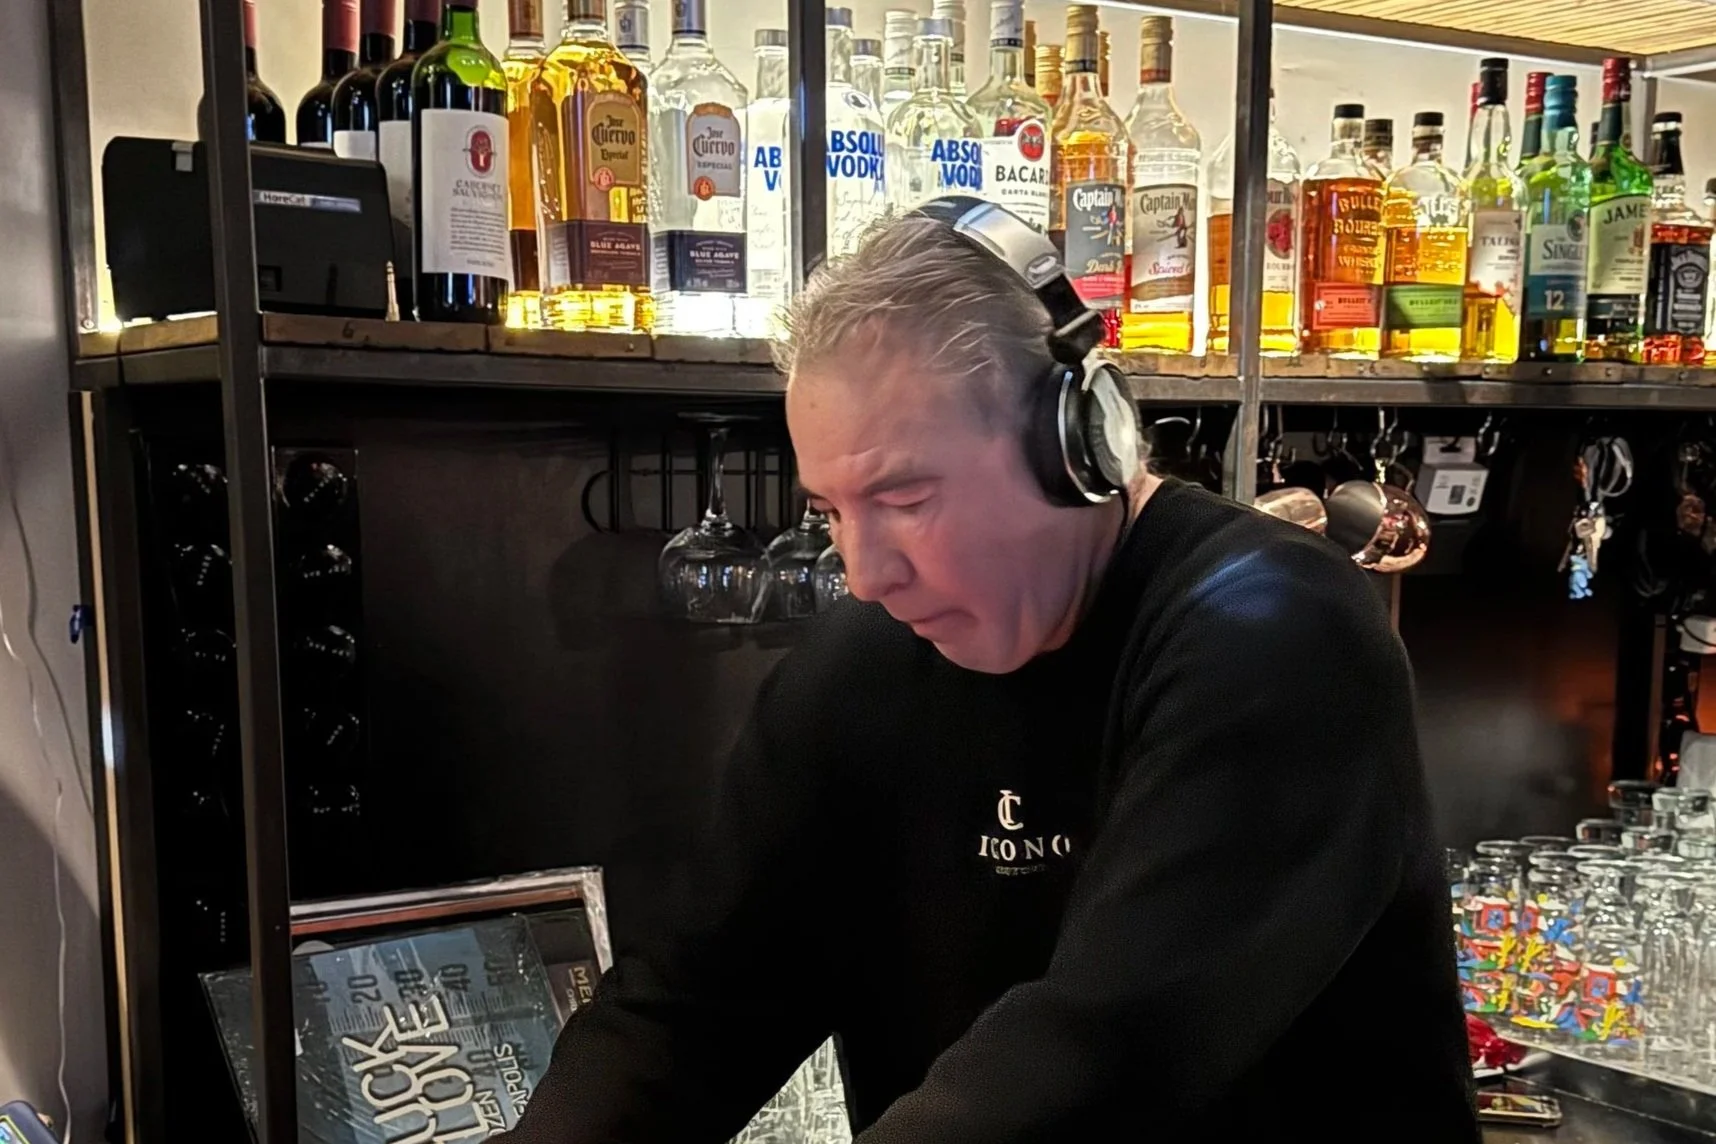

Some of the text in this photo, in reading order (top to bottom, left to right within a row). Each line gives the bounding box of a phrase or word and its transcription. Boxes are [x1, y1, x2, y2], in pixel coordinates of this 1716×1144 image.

[591, 122, 636, 147] Cuervo
[692, 133, 735, 157] Cuervo
[1072, 187, 1114, 212] Captain
[1140, 191, 1180, 215] Captain
[1544, 289, 1565, 311] 12
[384, 994, 487, 1141] LOVE
